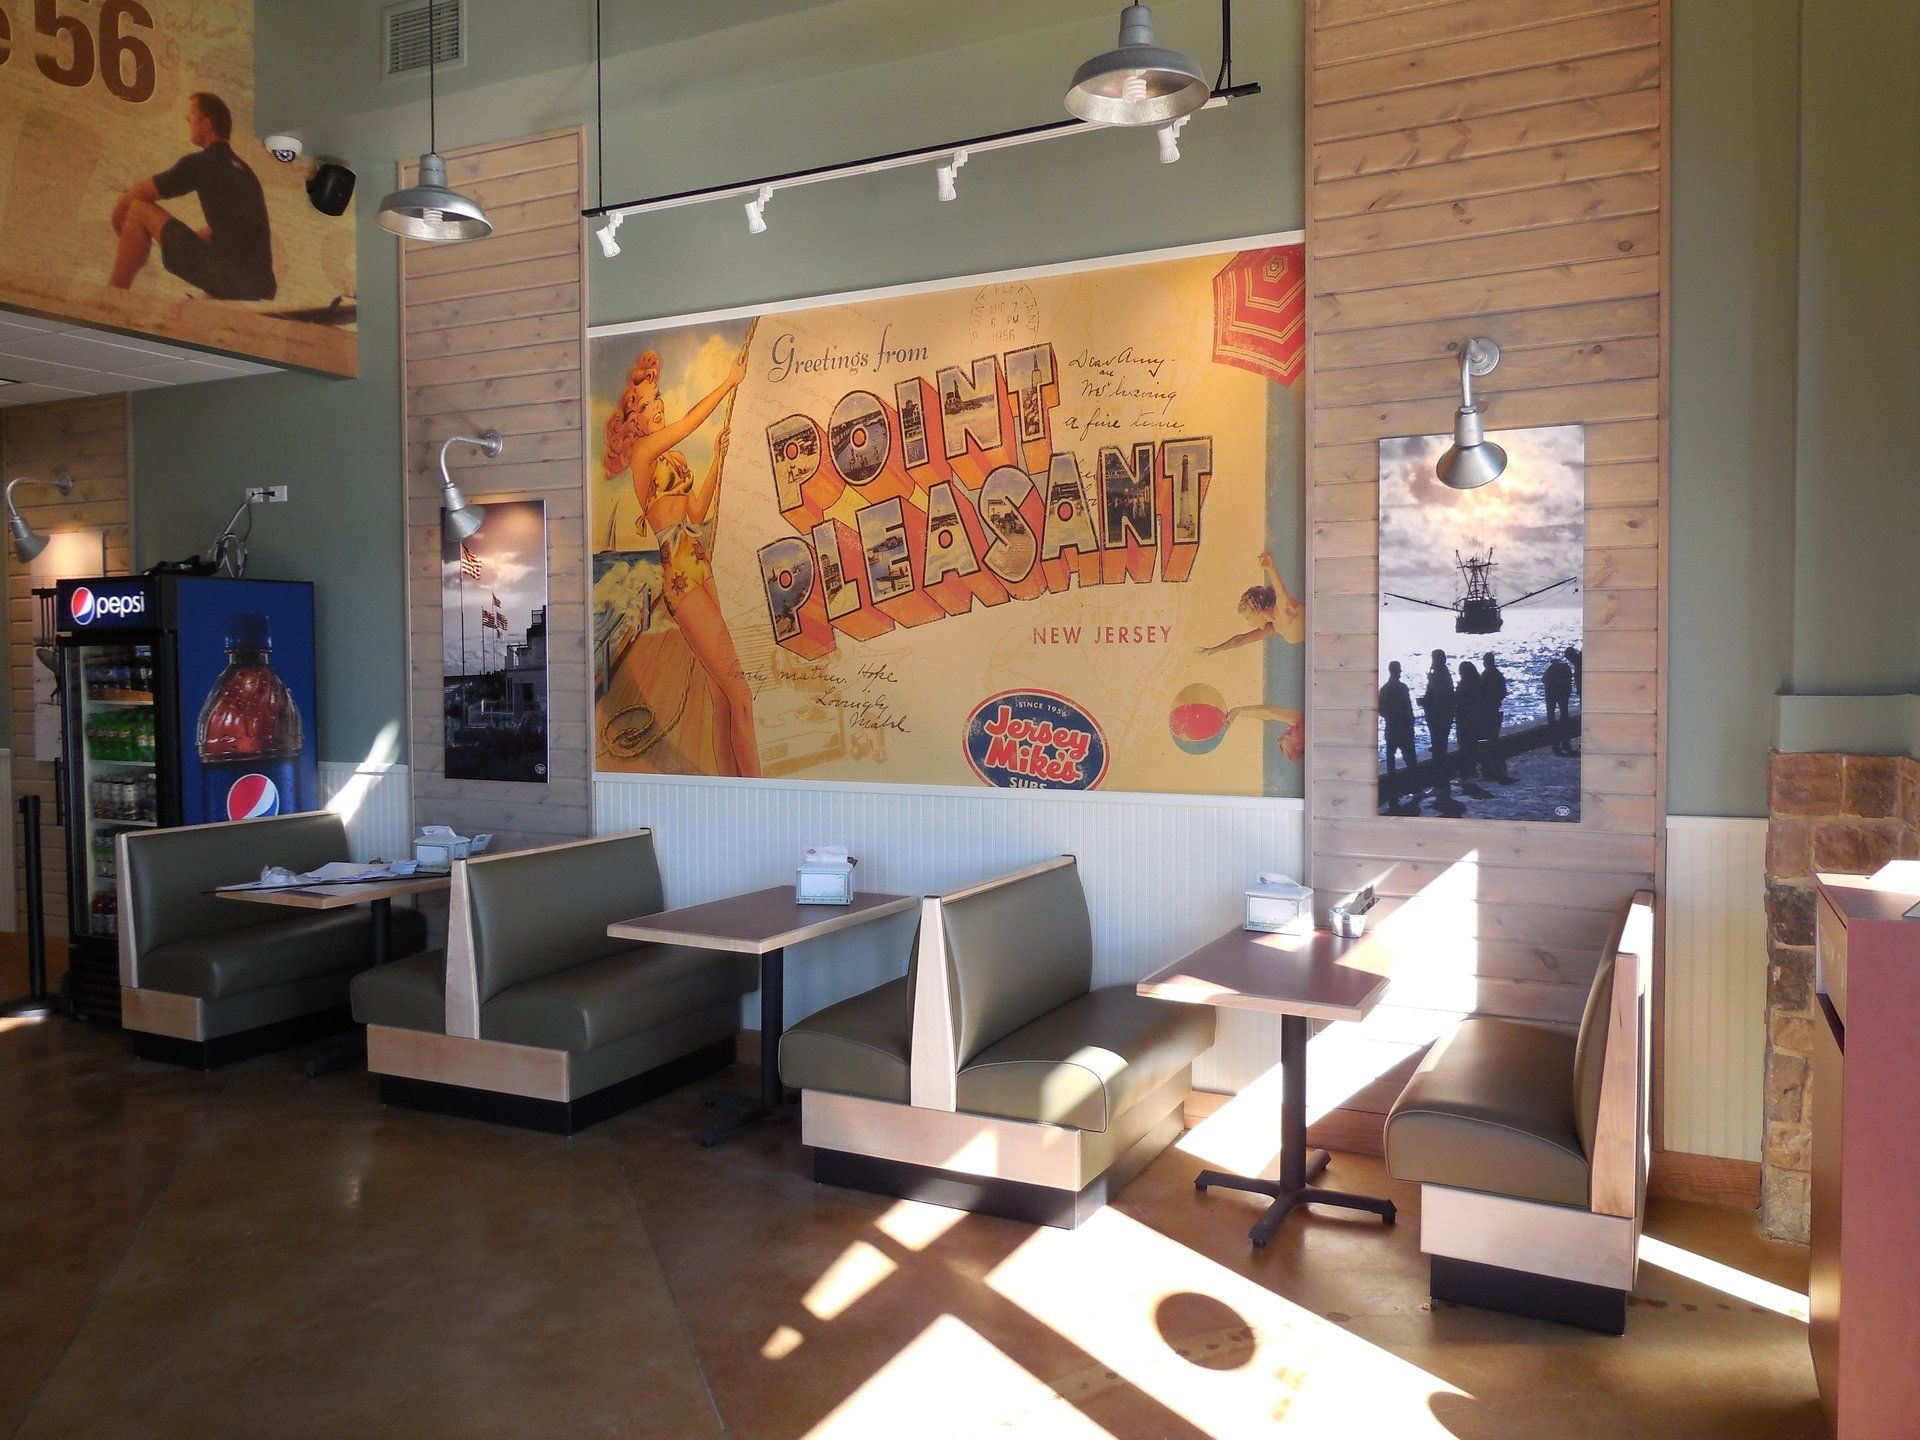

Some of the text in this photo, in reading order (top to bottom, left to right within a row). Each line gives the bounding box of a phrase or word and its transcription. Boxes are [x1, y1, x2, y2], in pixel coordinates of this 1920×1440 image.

[35, 0, 156, 103] 56
[767, 322, 929, 383] Greetings from
[1068, 348, 1117, 368] Dear
[1064, 416, 1078, 429] a
[1079, 407, 1121, 442] fine
[757, 341, 1215, 655] POINT PLEASANT
[96, 590, 145, 619] pepsi
[1033, 625, 1172, 645] NEW JERSEY
[1018, 701, 1067, 717] SINCE 1956
[984, 705, 1092, 762] Jersey
[984, 735, 1084, 784] Mike's
